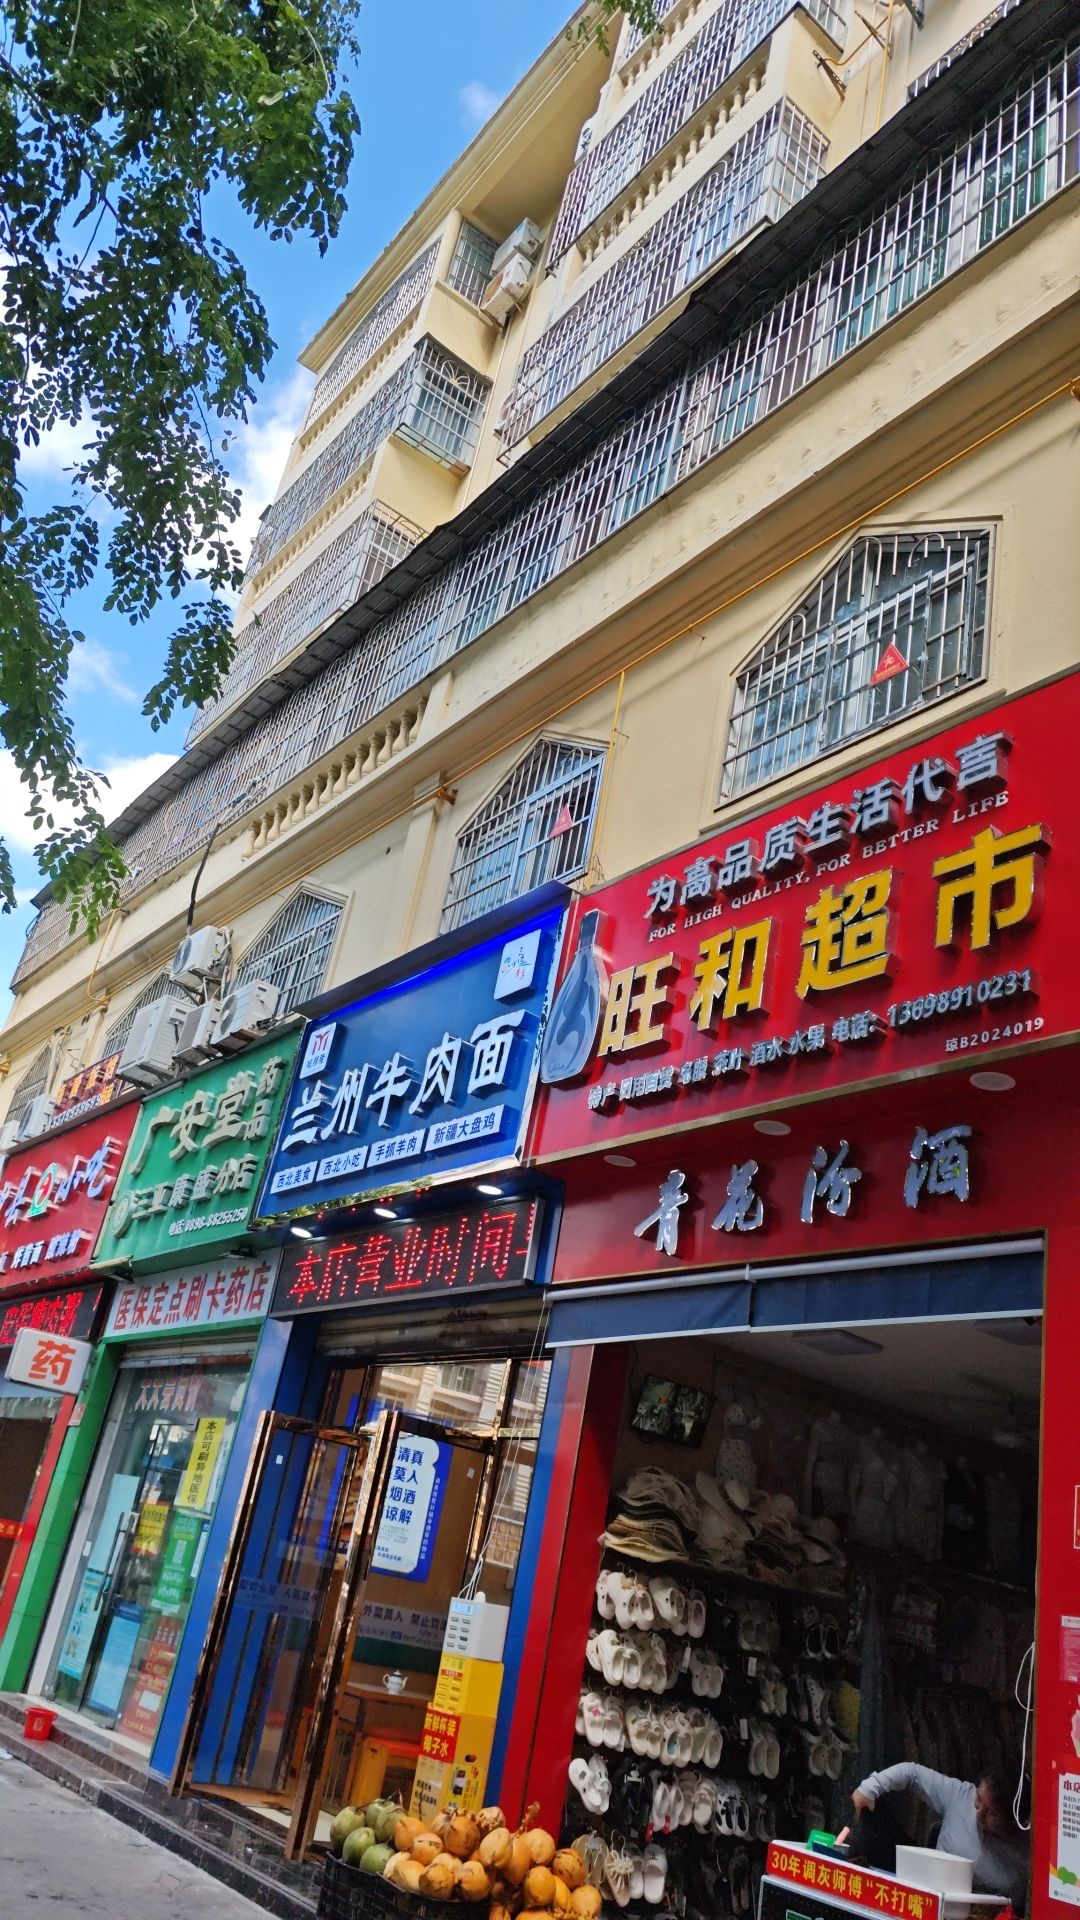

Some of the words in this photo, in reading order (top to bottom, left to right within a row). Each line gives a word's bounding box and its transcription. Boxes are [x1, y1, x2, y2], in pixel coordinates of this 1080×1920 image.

[644, 731, 1010, 919] 为高品质生活代言
[649, 923, 676, 942] FOR
[685, 906, 723, 929] HIGH
[731, 873, 812, 910] QUALITY,
[816, 853, 851, 877] FOR
[862, 818, 940, 859] BETTER
[952, 790, 1010, 823] LIFE
[597, 822, 1046, 1058] 旺和超市
[619, 1064, 676, 1101] 日用百货
[750, 1036, 786, 1067] 酒水
[790, 1022, 826, 1056] 水果
[887, 968, 1032, 1028] 13698910231
[945, 1016, 1046, 1053] 琼B2024019
[128, 1070, 258, 1176] 广安堂
[244, 1055, 285, 1141] 药品
[282, 1010, 524, 1152] 兰州牛肉面
[276, 1165, 312, 1190] 西北美食
[323, 1152, 362, 1177] 西北小吃
[375, 1135, 418, 1162] 手抓羊肉
[434, 1111, 497, 1144] 新疆大盘鸡
[634, 1125, 972, 1257] 青花汾酒
[112, 1262, 272, 1331] 医保定点刷卡药店
[28, 1339, 77, 1386] 药
[386, 1485, 417, 1506] 烟酒
[394, 1446, 425, 1467] 清真
[382, 1506, 413, 1525] 谅解
